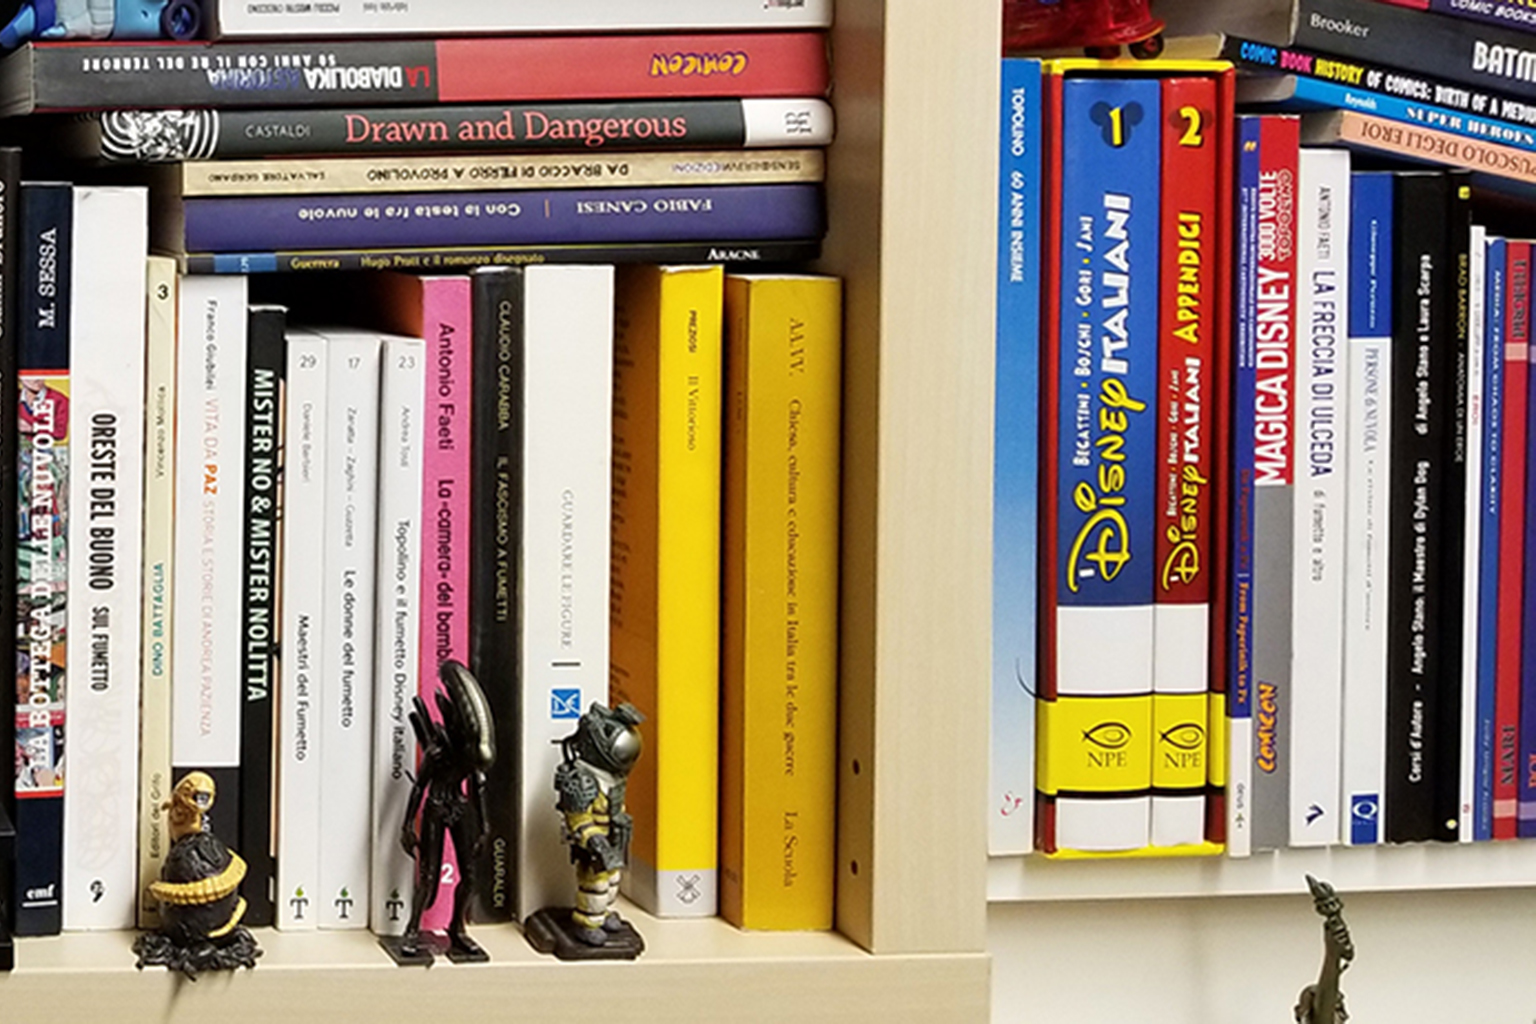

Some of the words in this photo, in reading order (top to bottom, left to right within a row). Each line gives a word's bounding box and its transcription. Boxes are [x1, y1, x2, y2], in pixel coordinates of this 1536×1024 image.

[1310, 12, 1371, 39] Brooker
[648, 51, 749, 78] COMICON
[245, 123, 311, 139] CASTALDI
[345, 112, 436, 143] Drawn
[443, 111, 515, 142] and
[524, 107, 688, 145] Dangerous
[1010, 87, 1025, 157] TOPOLINO
[1109, 109, 1124, 147] 1
[1178, 107, 1202, 147] 2
[1010, 170, 1025, 190] 60
[1258, 170, 1277, 219] VOLTE
[297, 207, 358, 222] nuvole
[363, 207, 380, 221] le
[384, 206, 409, 220] fra
[414, 204, 459, 219] testa
[464, 204, 480, 219] la
[485, 203, 522, 218] Con
[576, 199, 648, 214] CANESI
[653, 198, 714, 213] FABIO
[1010, 191, 1025, 228] ANNI
[1277, 168, 1293, 260] TOPOLINO
[1317, 186, 1332, 230] ANTONIO
[1010, 230, 1025, 283] INSIEME
[1258, 221, 1277, 262] 3000
[1317, 231, 1332, 260] FAETI
[37, 228, 57, 297] SESSA
[1310, 270, 1336, 295] LA
[1414, 254, 1433, 296] Scarpa
[156, 284, 170, 300] 3
[37, 304, 57, 329] M.
[498, 300, 511, 361] CLAUDIO
[1255, 264, 1289, 369] DISNEY
[1414, 298, 1433, 333] Laura
[437, 322, 455, 397] Antonio
[788, 317, 805, 378] AA.VV.
[1310, 301, 1336, 378] FRECCIA
[686, 375, 701, 387] Il
[1414, 344, 1433, 379] Stano
[252, 368, 274, 453] MISTER
[498, 364, 511, 431] CARABBA
[1310, 382, 1336, 402] DI
[1414, 380, 1433, 420] Angelo
[437, 403, 455, 450] Faeti
[686, 389, 701, 452] Vittorioso
[1255, 373, 1289, 486] MAGICA
[1414, 422, 1433, 435] di
[91, 413, 116, 482] ORESTE
[1310, 406, 1336, 477] ULCEDA
[252, 458, 274, 492] NO
[91, 488, 116, 522] DEL
[252, 495, 274, 513] &
[91, 526, 116, 591] BUONO
[249, 519, 270, 602] MISTER
[395, 519, 411, 581] Topolino
[343, 571, 357, 589] Le
[396, 585, 407, 595] e
[91, 606, 110, 633] SUL
[343, 592, 357, 639] donne
[395, 598, 410, 608] il
[249, 607, 270, 702] NOLITTA
[296, 614, 310, 670] Maestri
[343, 642, 357, 666] del
[393, 610, 407, 669] fumetto
[91, 635, 110, 691] FUMETTO
[296, 673, 310, 697] del
[343, 669, 357, 728] fumetto
[389, 672, 407, 723] Disney
[296, 700, 310, 760] Fumetto
[1257, 683, 1278, 775] COMICON
[1409, 701, 1424, 750] d'Autore
[391, 725, 405, 779] italiano
[1086, 751, 1128, 769] NPE
[1164, 751, 1202, 769] NPE
[1409, 751, 1424, 783] Corsi
[784, 811, 800, 831] La
[784, 834, 800, 888] Scuola
